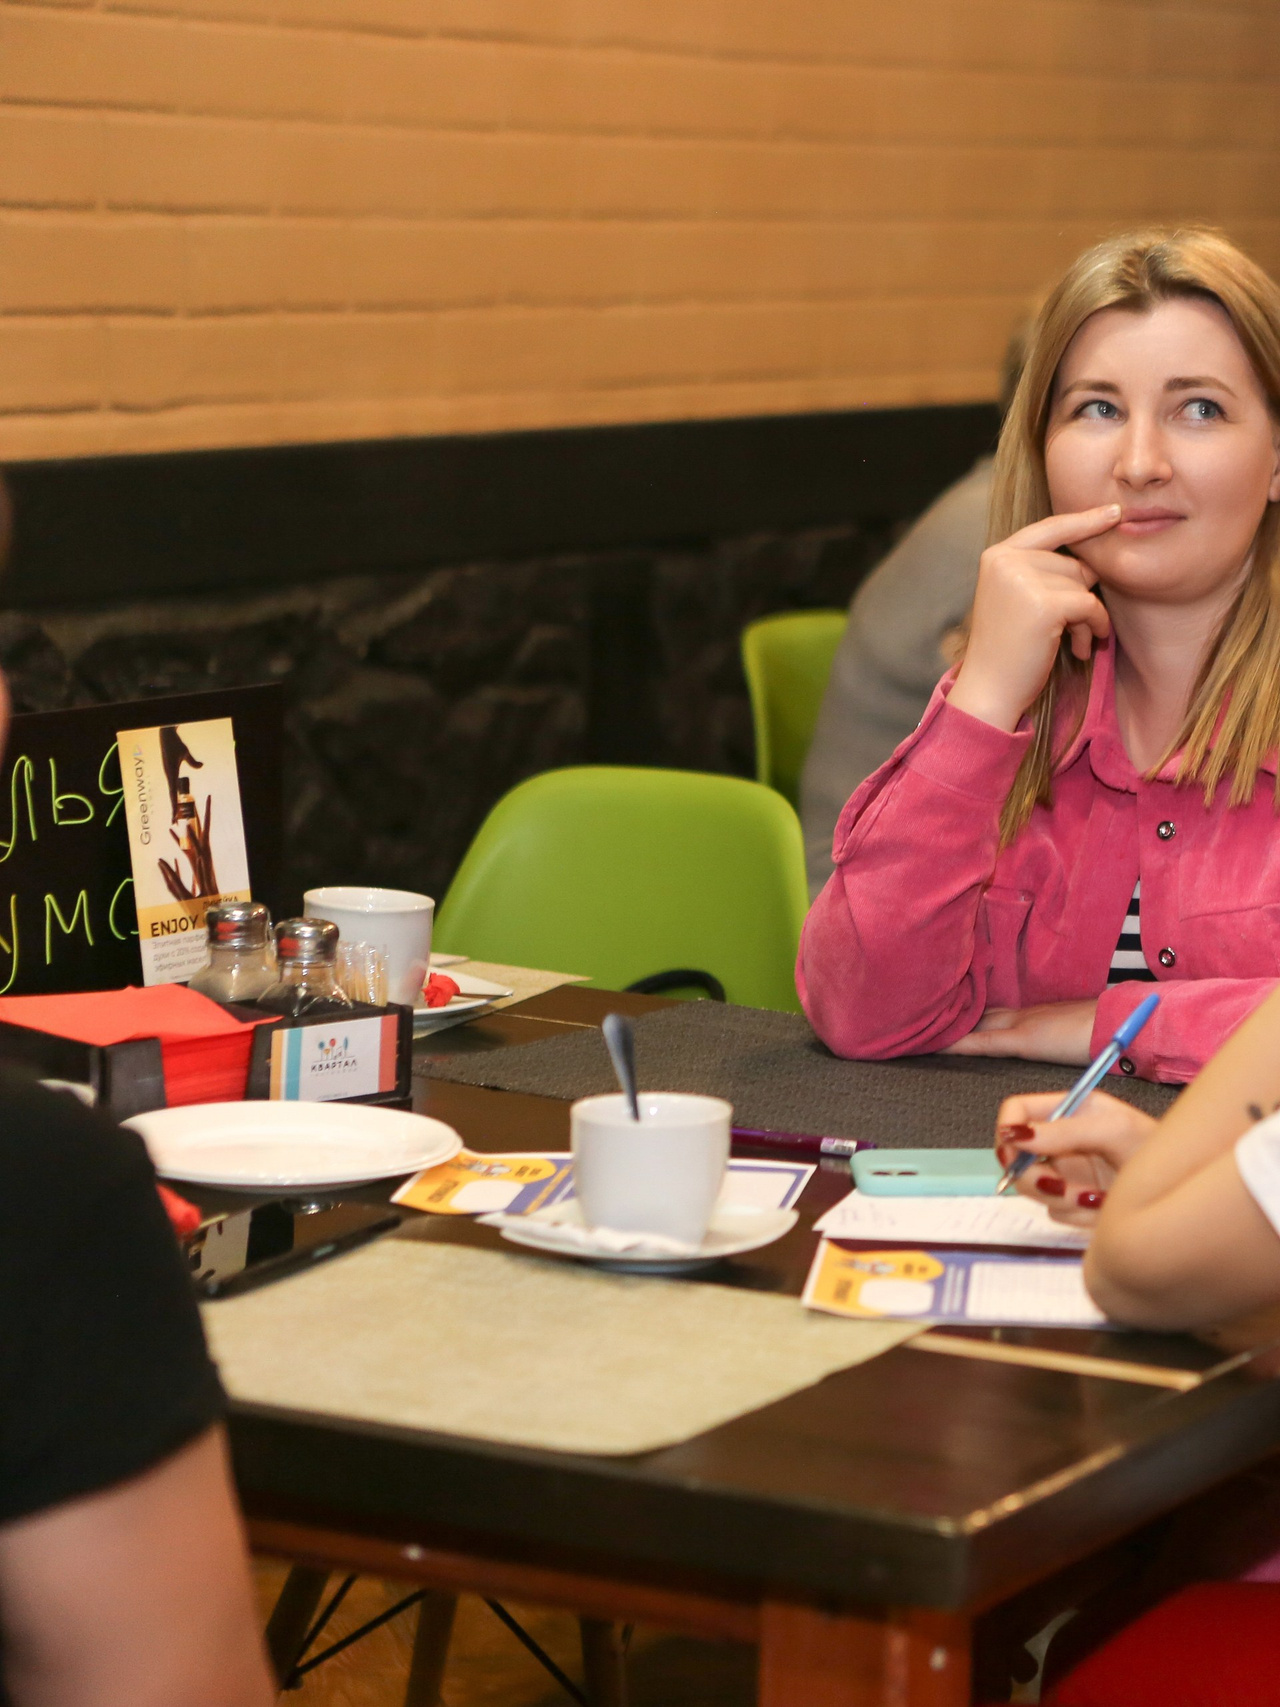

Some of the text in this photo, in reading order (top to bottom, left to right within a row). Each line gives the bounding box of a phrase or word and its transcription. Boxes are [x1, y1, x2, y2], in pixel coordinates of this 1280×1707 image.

[133, 756, 152, 846] Greenway
[150, 915, 198, 937] ENJOY
[310, 1058, 358, 1073] КВАРТАЛ
